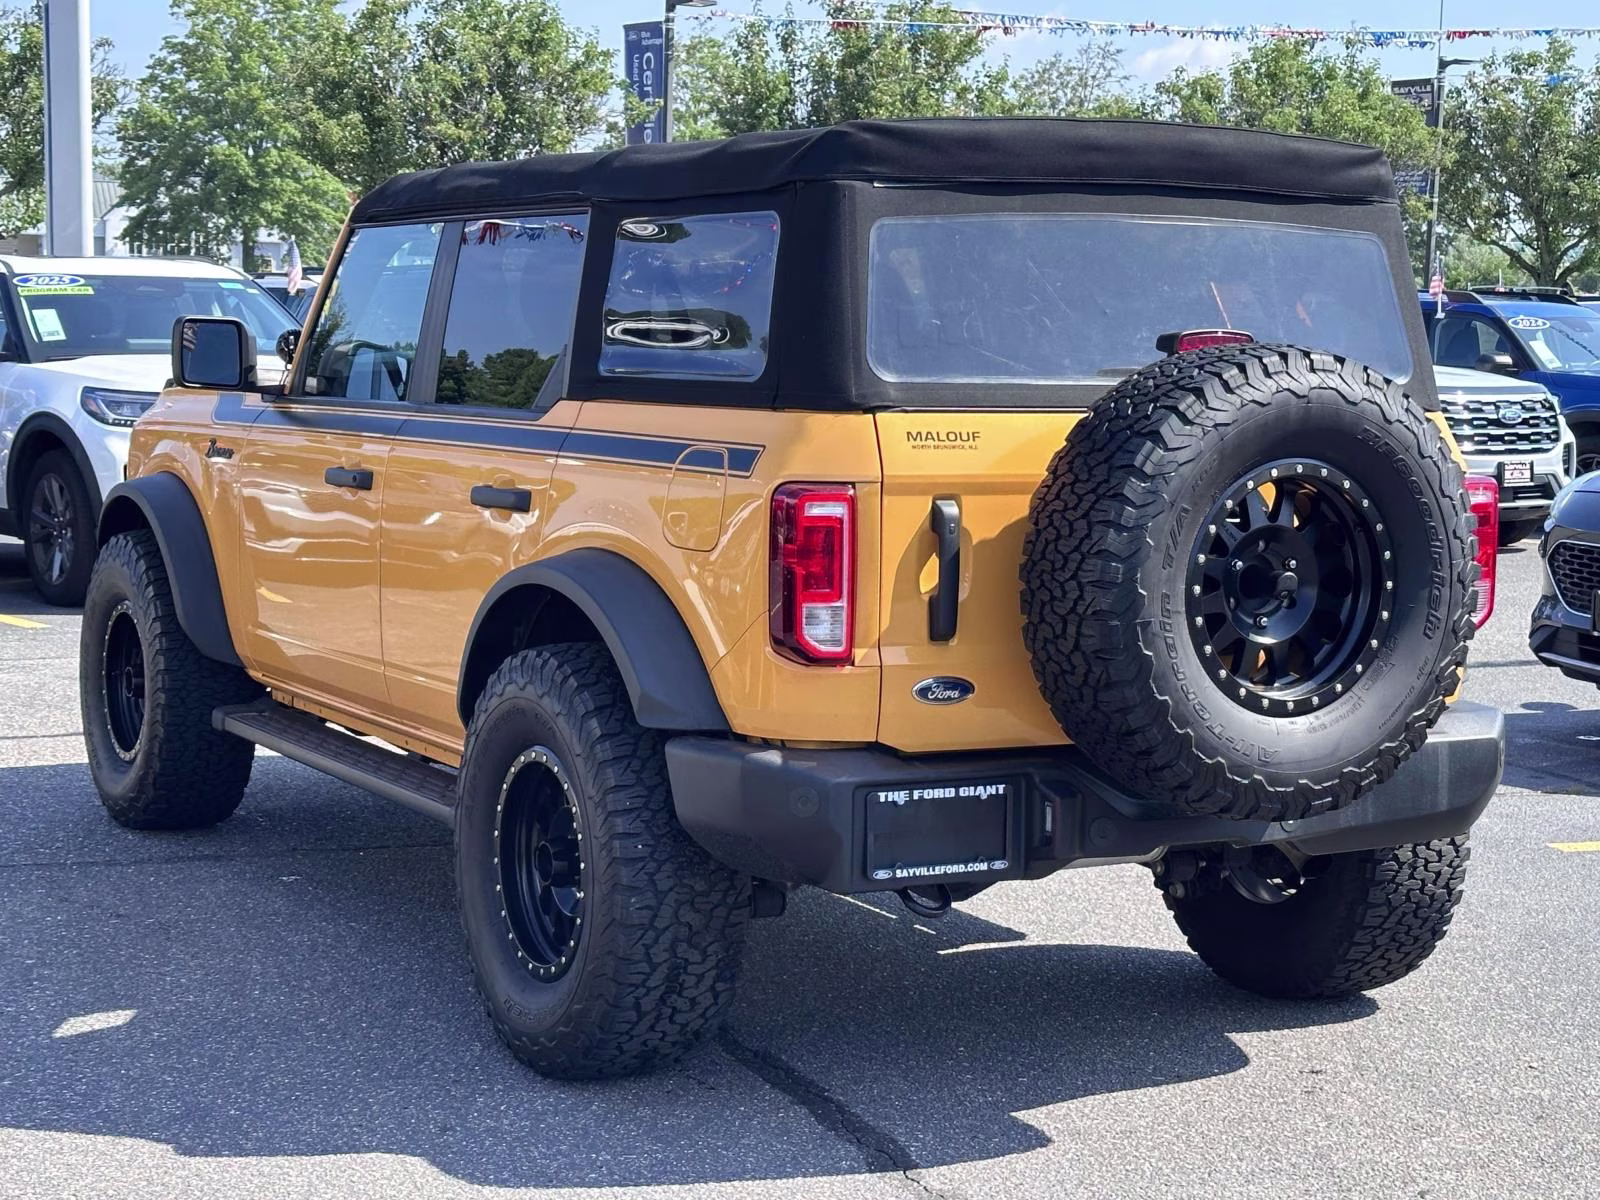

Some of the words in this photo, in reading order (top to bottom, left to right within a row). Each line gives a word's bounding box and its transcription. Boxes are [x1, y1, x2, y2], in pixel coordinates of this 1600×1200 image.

[1393, 85, 1432, 95] SAYVILLE
[27, 275, 71, 285] 2025
[1516, 319, 1543, 328] 2024
[906, 431, 981, 442] MALOUF
[927, 683, 961, 699] Ford
[878, 790, 910, 803] THE
[913, 787, 955, 800] FORD
[959, 784, 1007, 798] GIANT
[895, 862, 988, 878] SAYVILLEFORD.COM
